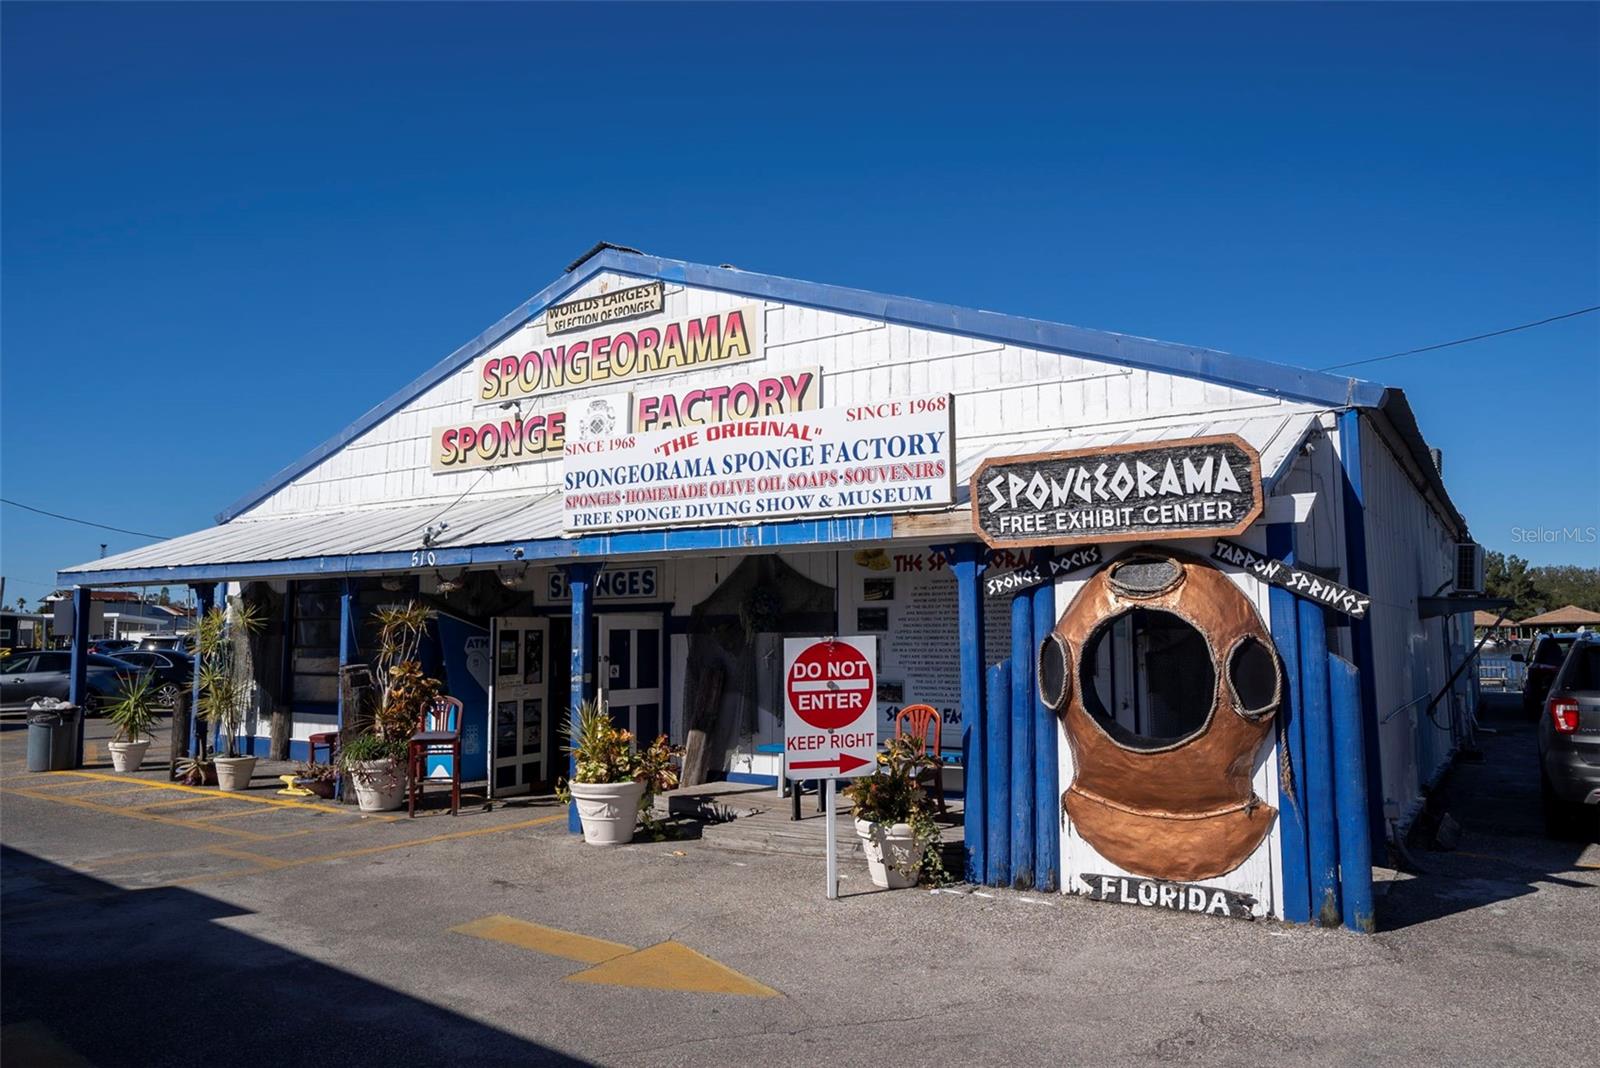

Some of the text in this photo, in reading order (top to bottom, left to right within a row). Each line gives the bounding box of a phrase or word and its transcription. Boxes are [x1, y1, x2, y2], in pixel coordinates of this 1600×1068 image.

[549, 284, 658, 319] WORLDS LARGEST
[554, 299, 655, 331] SELECTION OF SPONGES
[481, 310, 750, 400] SPONGEORAMA
[639, 372, 814, 432] FACTORY
[846, 396, 946, 422] SINCE 1968
[440, 411, 566, 465] SPONGE
[565, 437, 636, 456] SINCE 1968
[565, 431, 945, 490] SPONGEORAMA SPONGE FACTORY
[709, 477, 754, 496] OLIVE
[757, 475, 785, 492] OIL
[986, 453, 1242, 513] SPONGEORAMA
[573, 485, 932, 526] FREE SPONGE DIVING SHOW & MUSEUM
[1000, 501, 1233, 533] FREE EXHIBIT CENTER
[411, 551, 436, 567] 510
[987, 565, 1041, 595] SPONGE
[1048, 547, 1099, 574] DOCKS
[1216, 542, 1369, 614] TARPON SPRINGS
[793, 660, 867, 679] DO NOT
[798, 692, 863, 711] ENTER
[787, 733, 874, 750] KEEP RIGHT
[1101, 876, 1231, 916] FLORIDA
